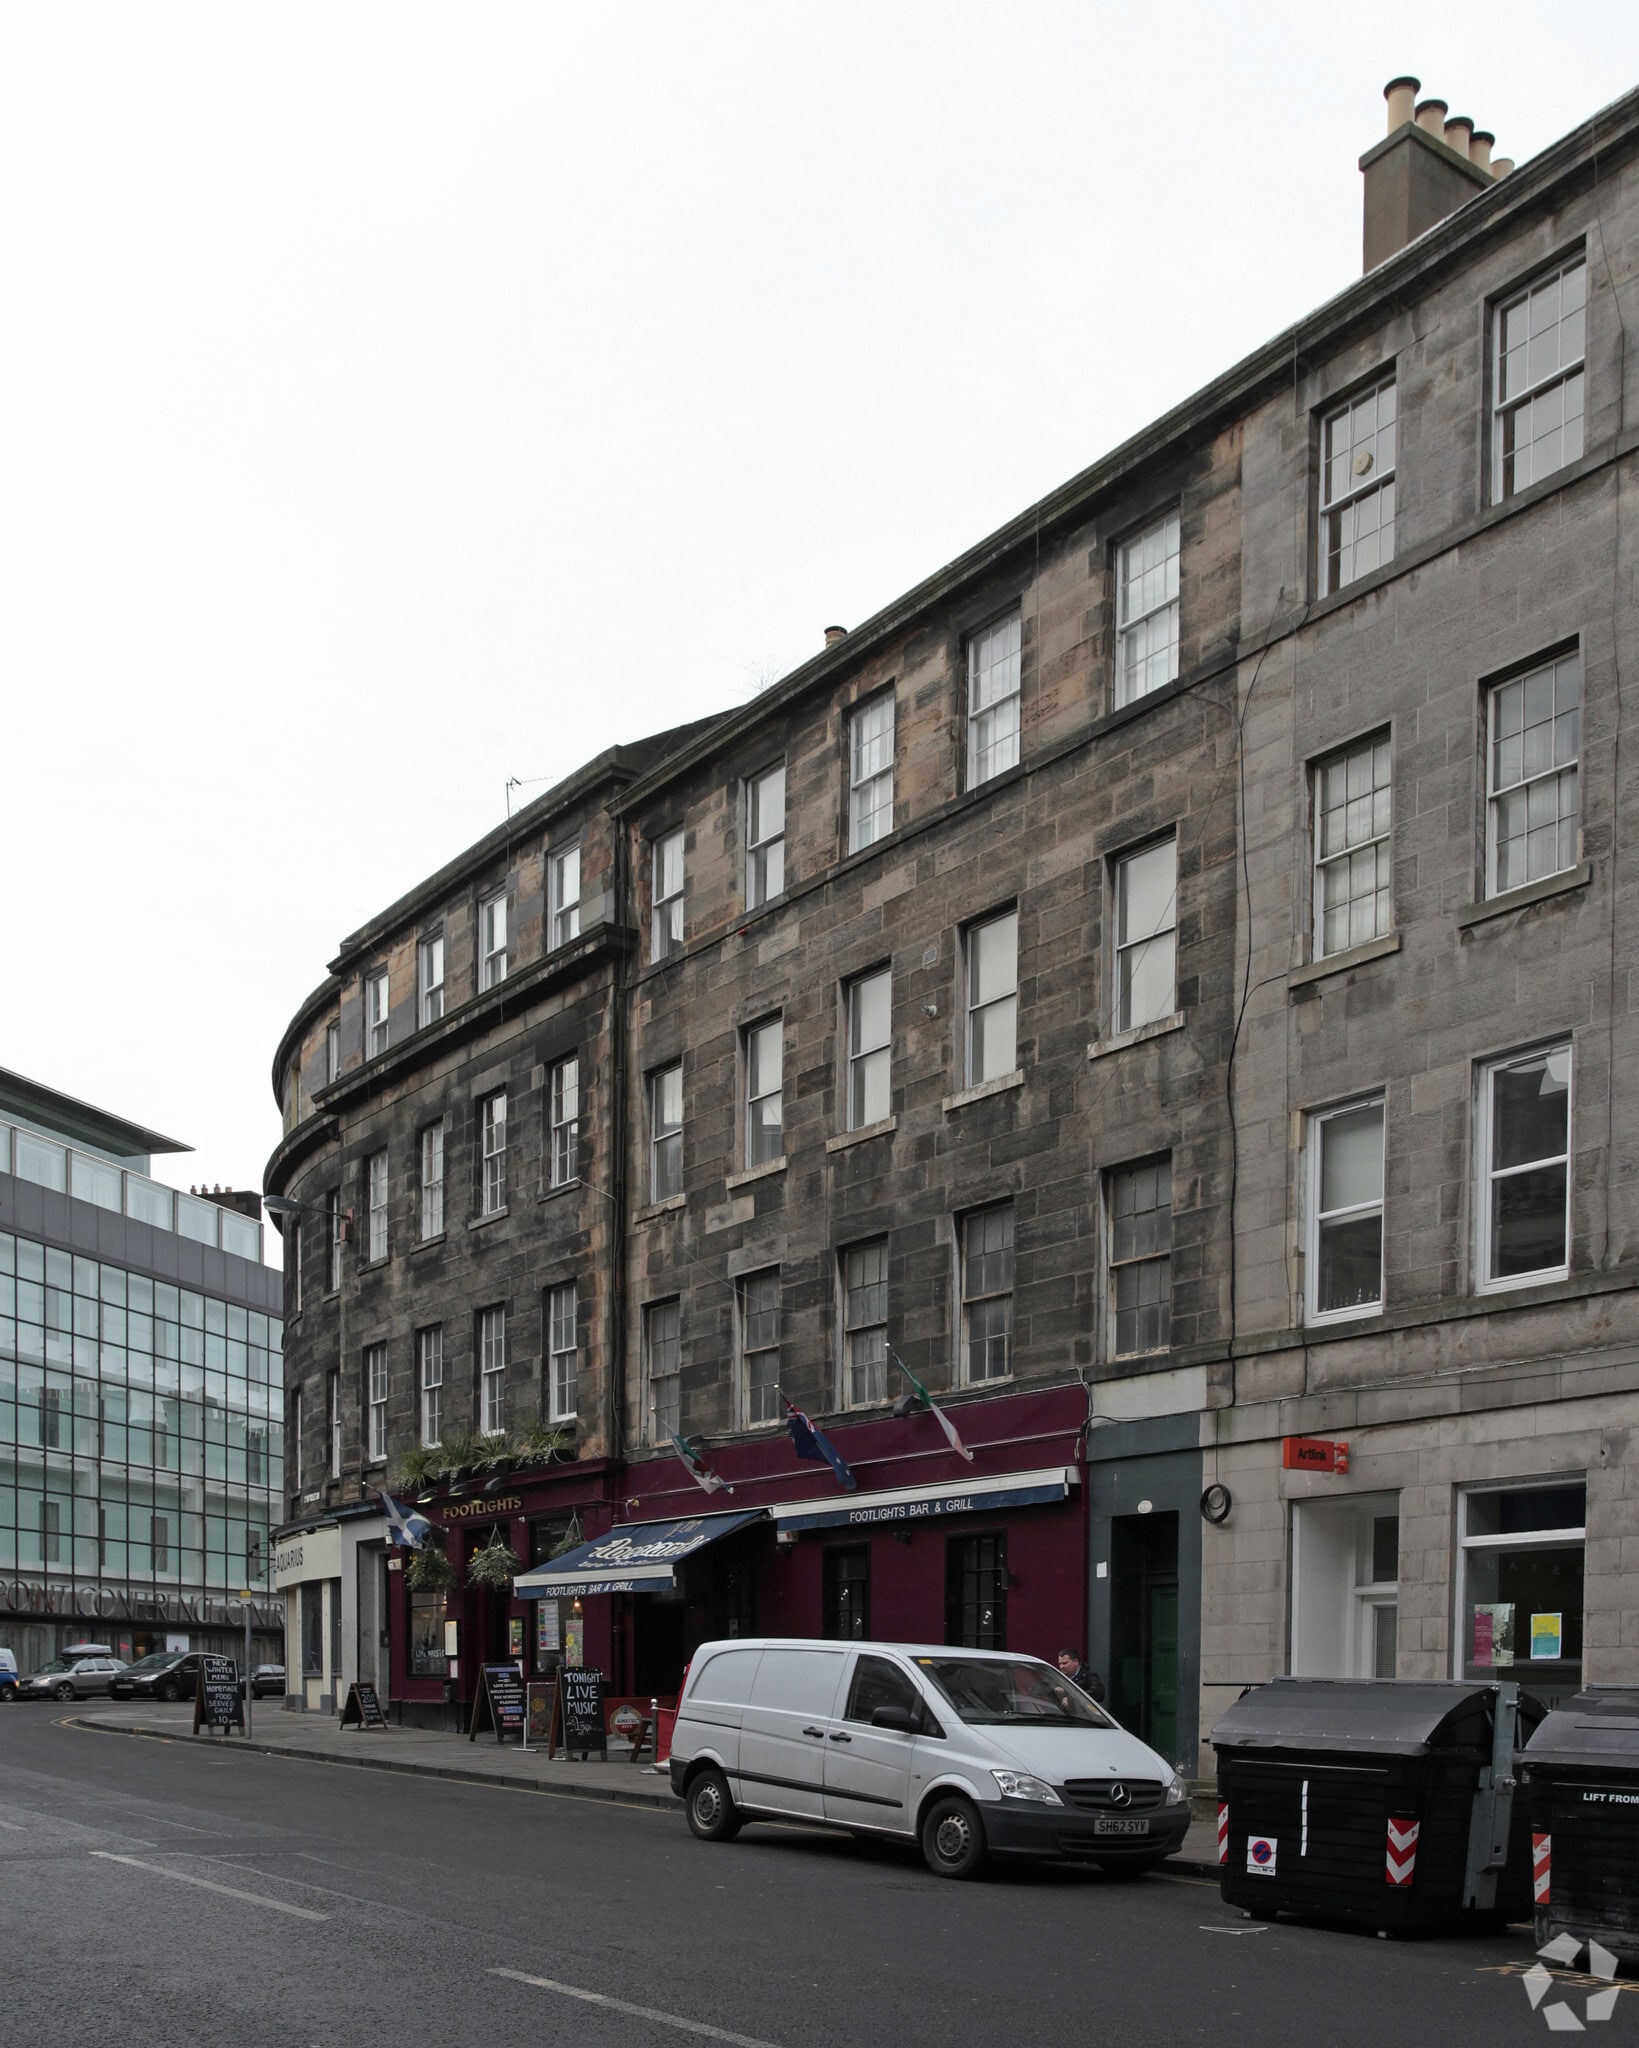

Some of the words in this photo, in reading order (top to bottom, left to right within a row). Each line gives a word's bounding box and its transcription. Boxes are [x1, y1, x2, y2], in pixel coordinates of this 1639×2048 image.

[1298, 1448, 1327, 1461] Artlink
[443, 1497, 522, 1519] FOOTLIGHTS
[849, 1506, 906, 1523] FOOTLIGHTS
[909, 1503, 929, 1516] BAR
[934, 1501, 941, 1512] &
[946, 1498, 974, 1511] GRILL
[274, 1547, 304, 1574] AQUARIUS
[546, 1585, 587, 1597] FOOTLIGHTS
[588, 1584, 601, 1594] BAR
[603, 1583, 610, 1591] &
[612, 1581, 634, 1591] GRILL
[77, 1586, 221, 1624] CONFERENCE
[206, 1666, 234, 1674] WINTER
[564, 1672, 601, 1684] TONIGHT
[206, 1685, 239, 1693] HOMEMADE
[566, 1685, 598, 1700] LIVE
[208, 1700, 235, 1708] SERVED
[567, 1701, 598, 1716] MUSIC
[218, 1715, 229, 1724] 10
[1583, 1792, 1607, 1802] LIFT
[1609, 1793, 1639, 1804] FROM
[1099, 1821, 1126, 1832] SH62
